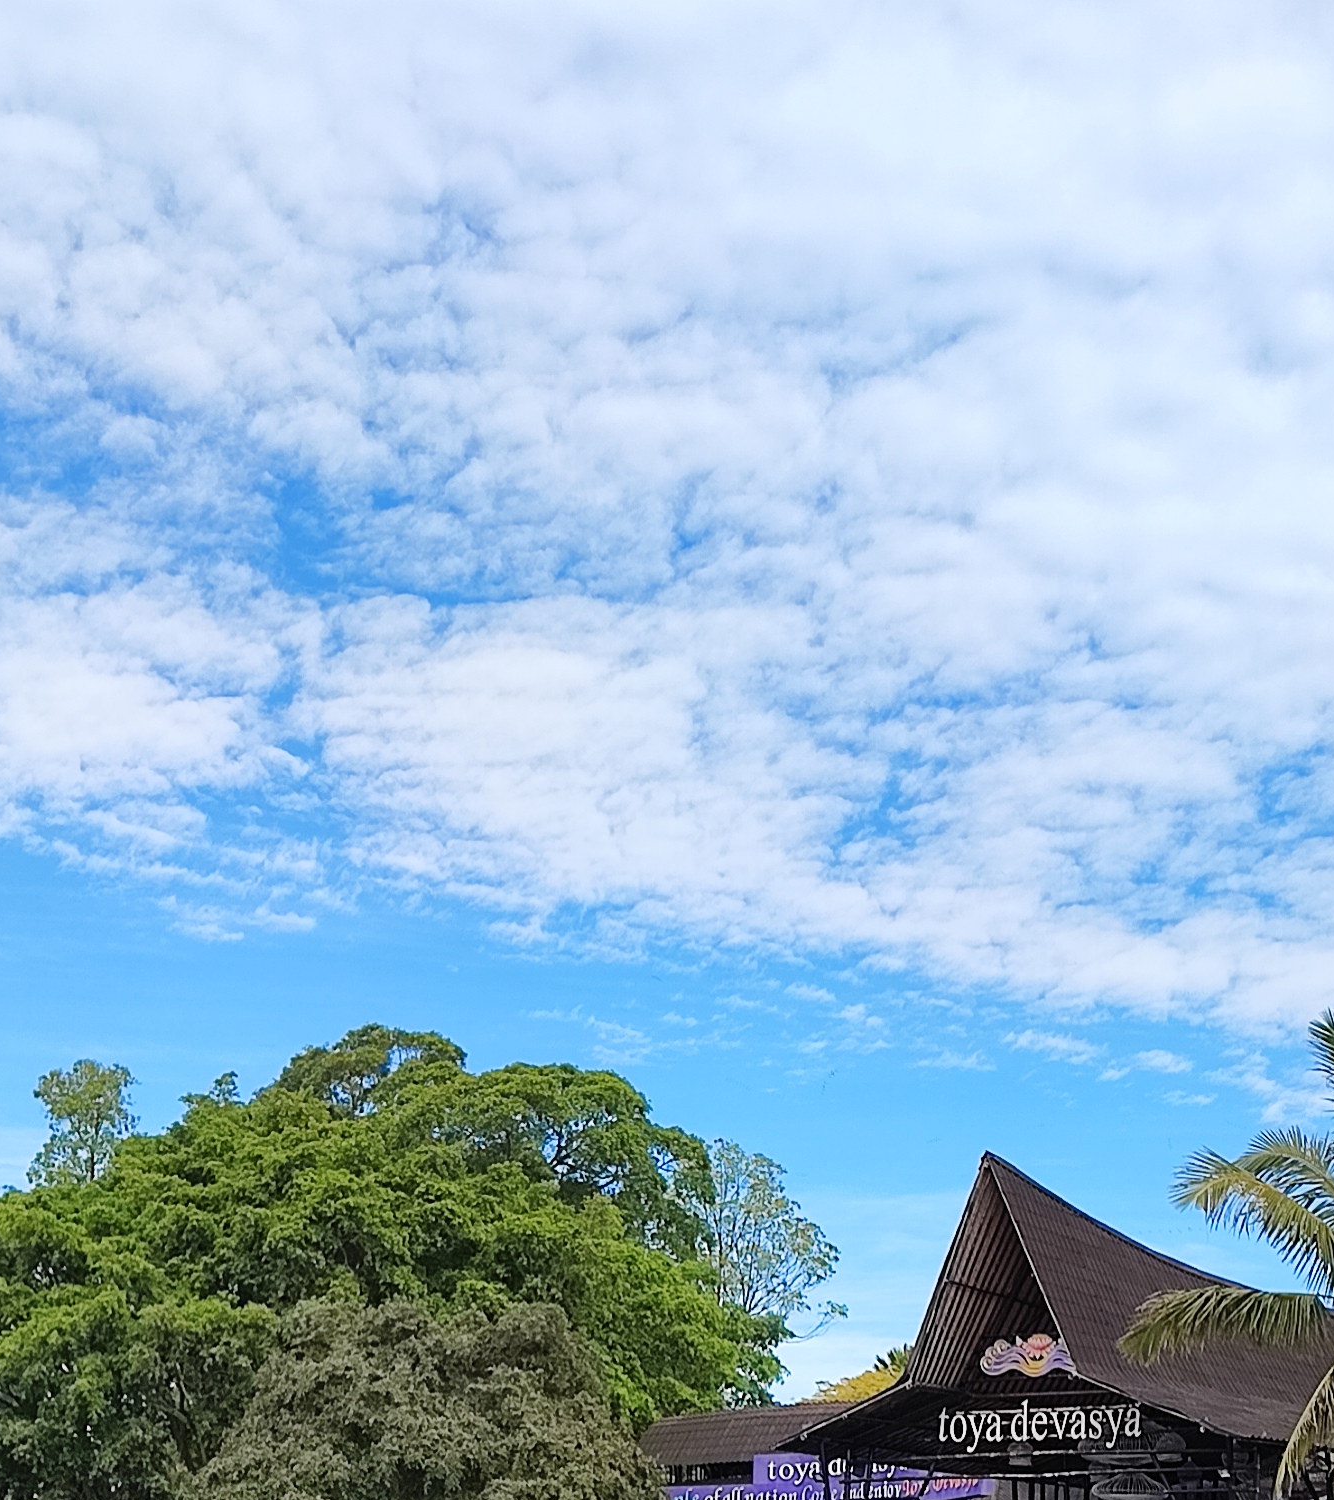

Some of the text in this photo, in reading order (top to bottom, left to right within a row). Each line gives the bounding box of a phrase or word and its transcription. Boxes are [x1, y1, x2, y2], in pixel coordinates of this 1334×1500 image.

[938, 1398, 1142, 1454] toya devasya
[767, 1460, 821, 1486] toya
